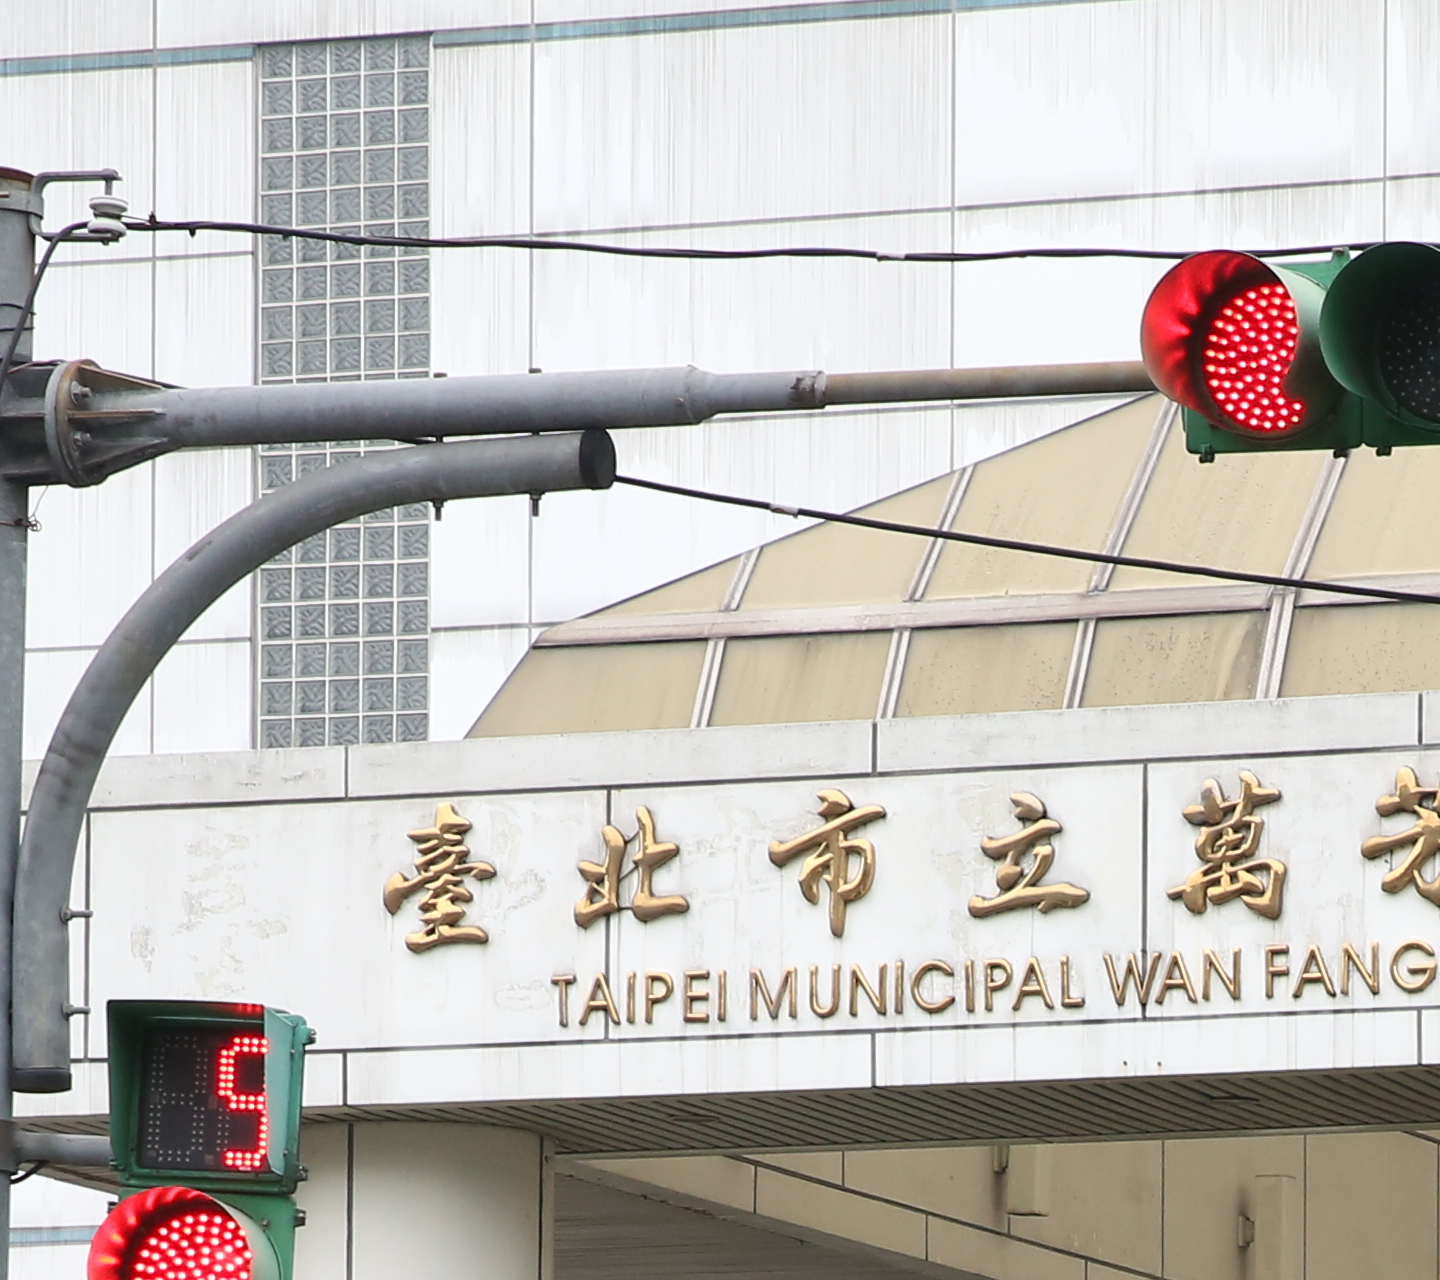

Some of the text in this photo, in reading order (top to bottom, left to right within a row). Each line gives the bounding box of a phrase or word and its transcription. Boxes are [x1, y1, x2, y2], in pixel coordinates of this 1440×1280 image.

[551, 969, 727, 1027] TAIPEI
[749, 955, 1086, 1021] MUNICIPAL
[1103, 947, 1242, 1003] WAN
[1264, 939, 1438, 998] FANG
